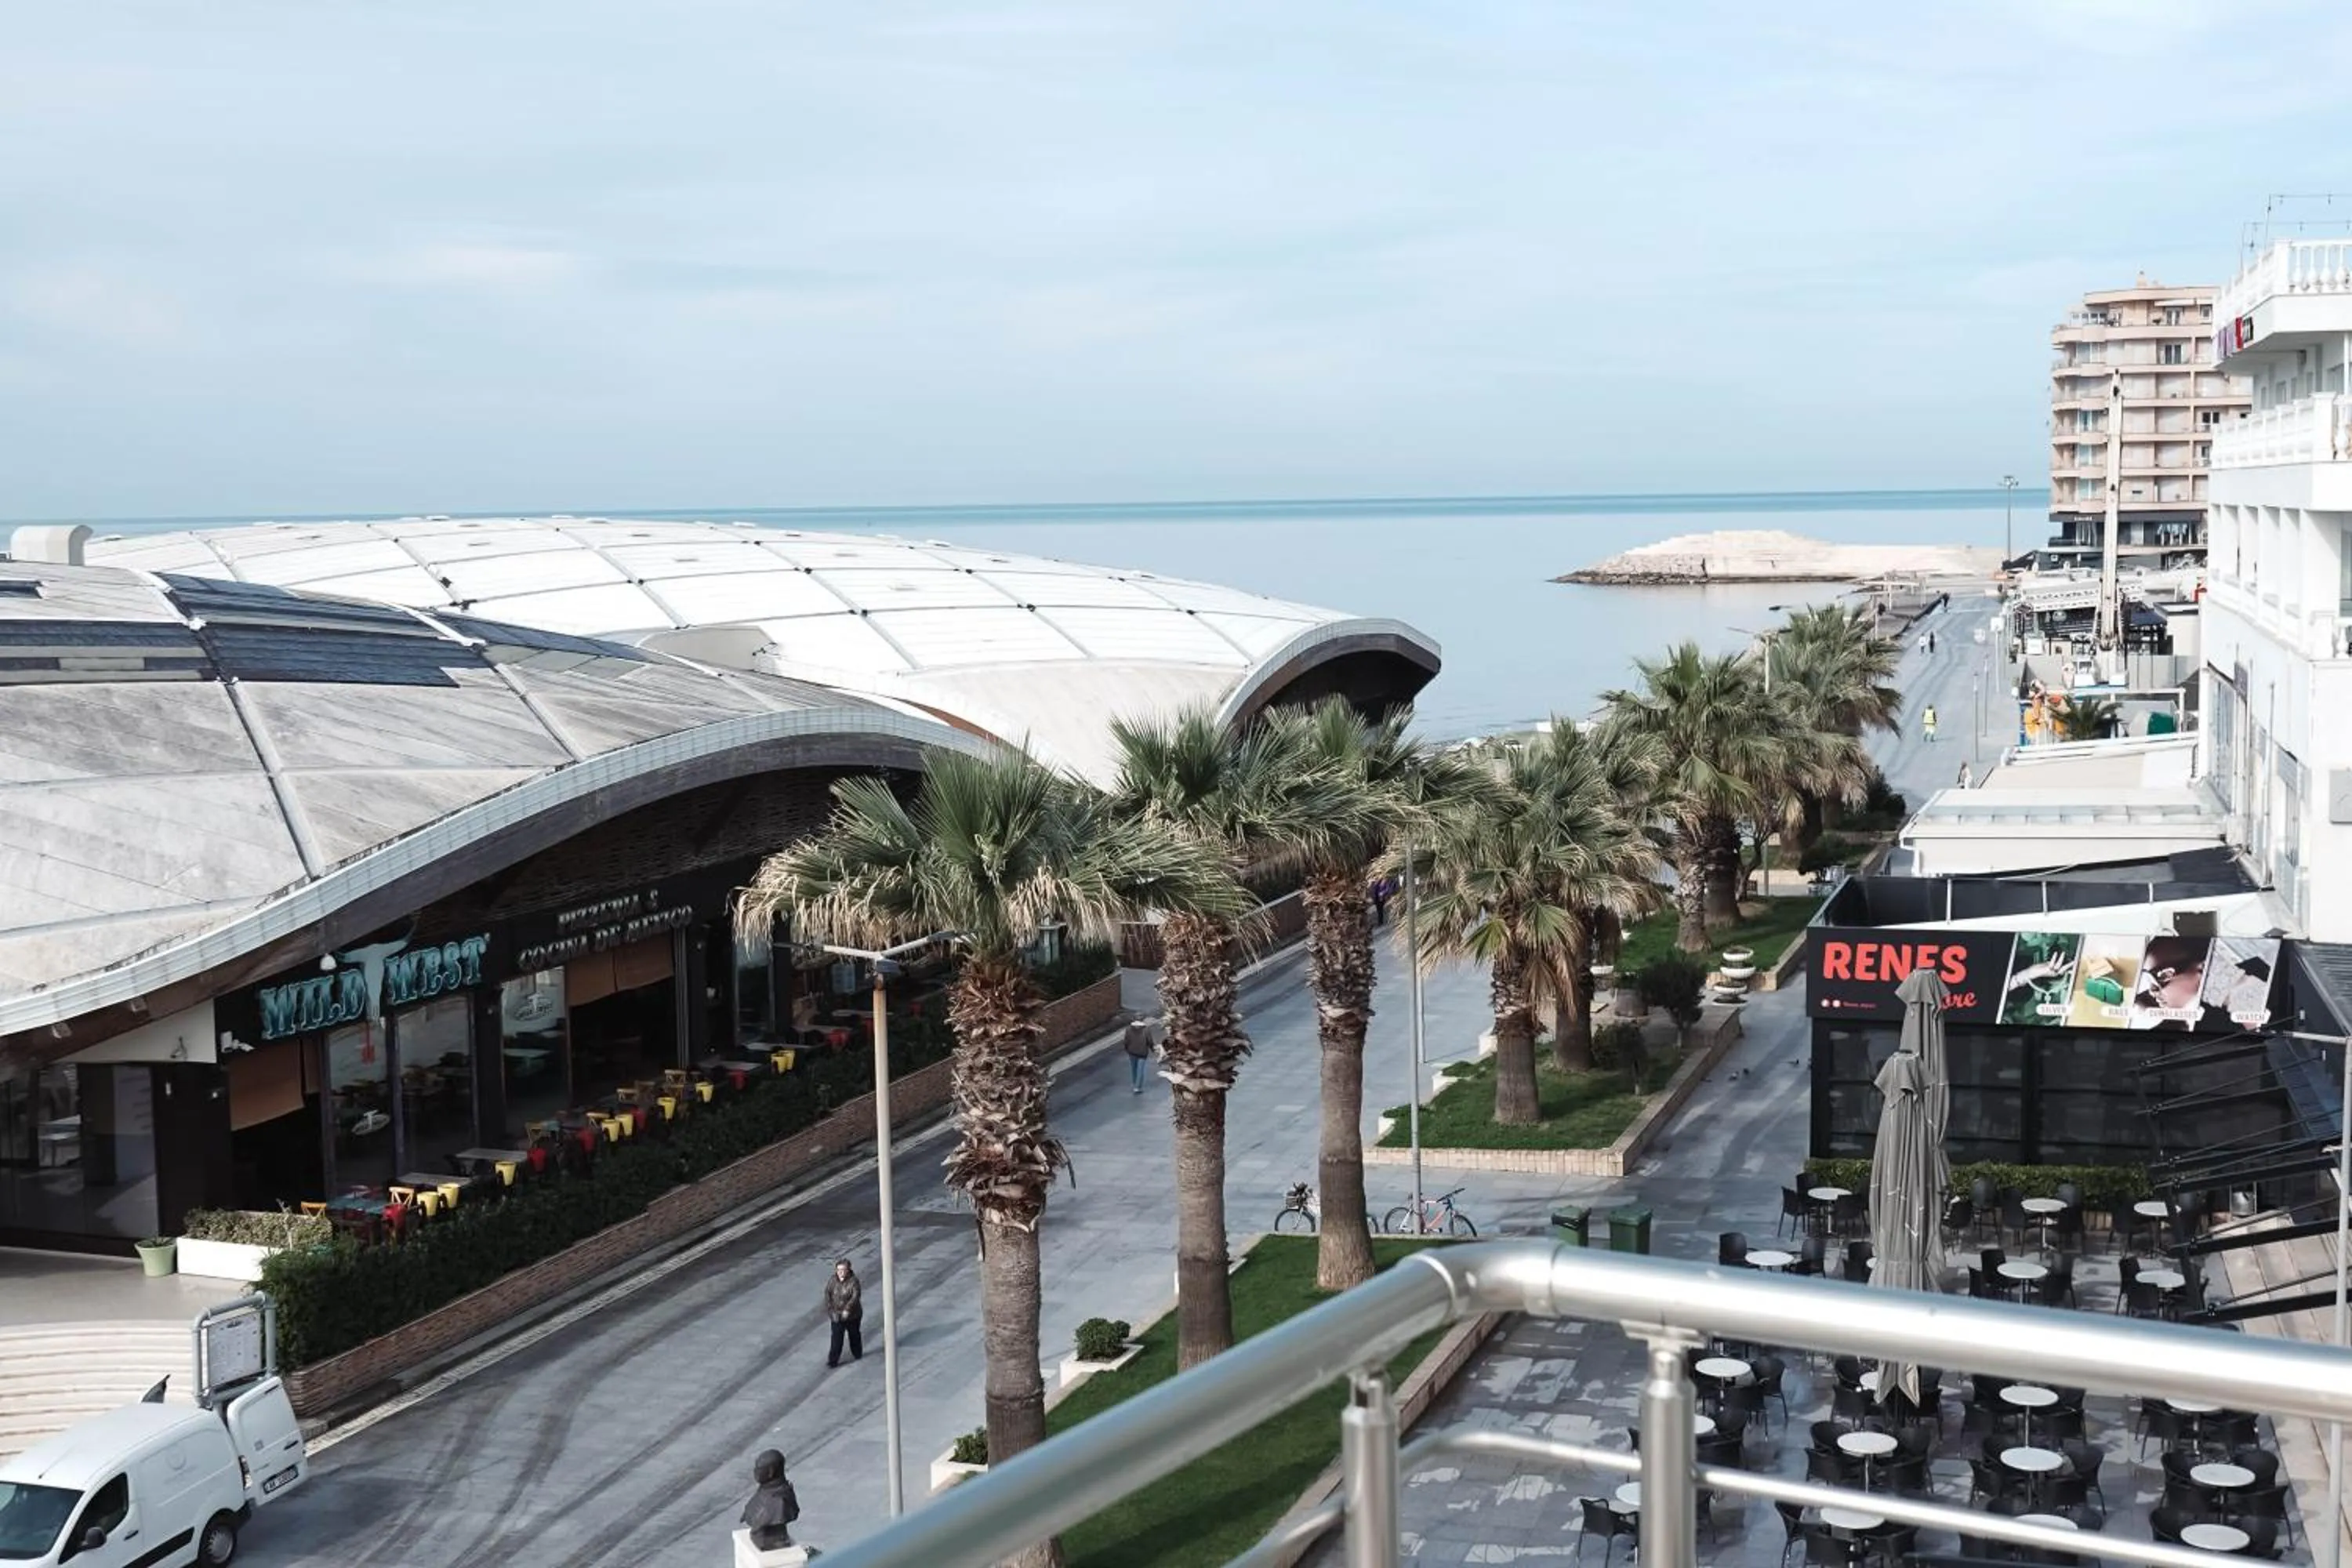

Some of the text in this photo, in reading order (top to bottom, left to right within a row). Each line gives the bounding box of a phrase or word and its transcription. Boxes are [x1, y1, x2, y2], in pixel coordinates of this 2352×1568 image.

[518, 935, 587, 971] COCINA
[595, 925, 621, 953] DE
[1823, 942, 1967, 984] RENES
[260, 937, 486, 1040] WILD WEST
[2236, 1012, 2265, 1021] WATCH
